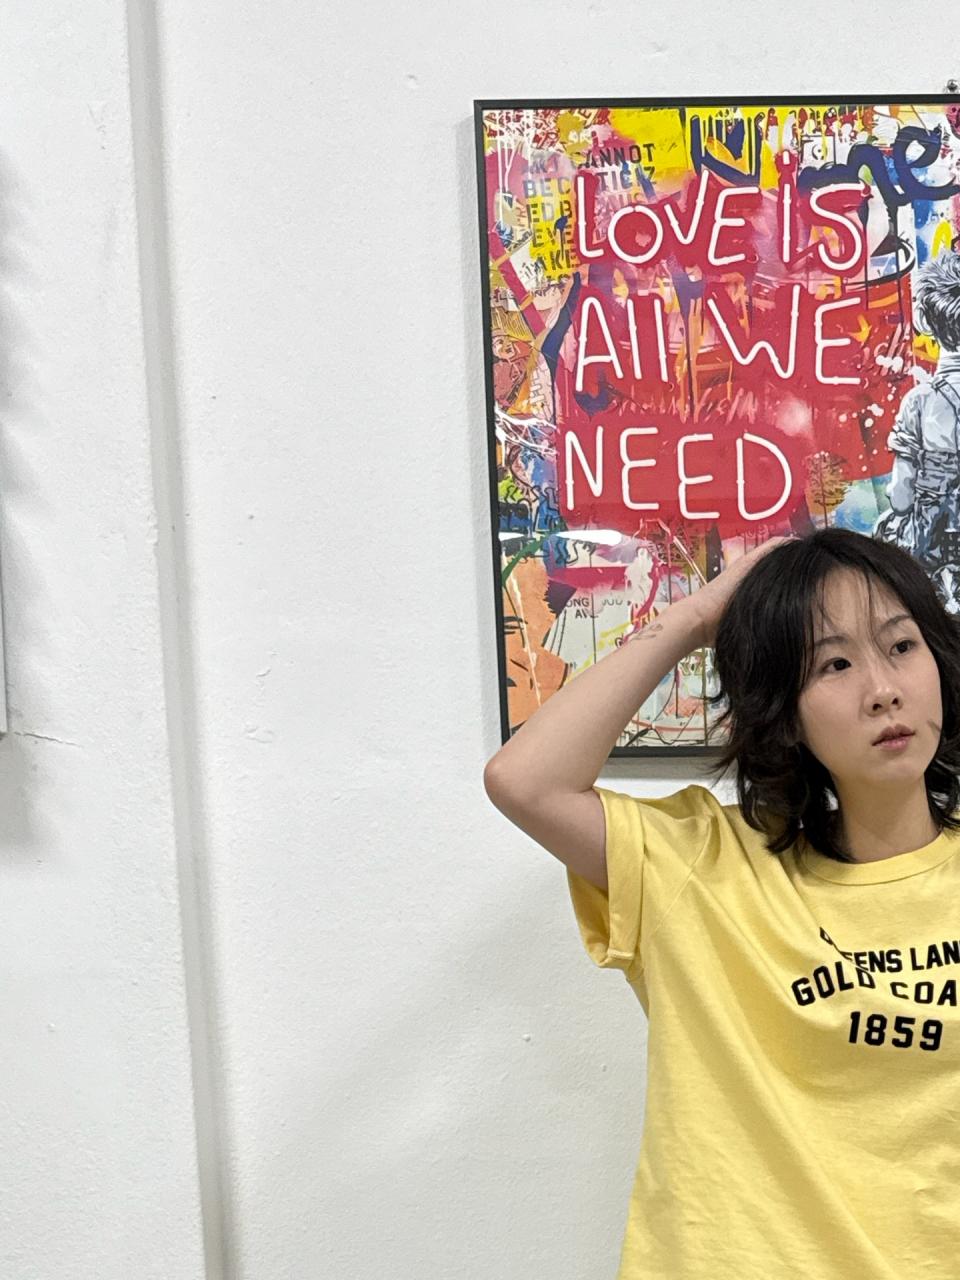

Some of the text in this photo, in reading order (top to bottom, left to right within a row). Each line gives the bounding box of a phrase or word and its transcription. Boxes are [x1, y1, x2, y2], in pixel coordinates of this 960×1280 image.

[574, 169, 761, 266] LOVE
[707, 284, 862, 384] WE
[565, 426, 793, 521] NEED
[791, 961, 876, 1006] GOLD
[848, 1011, 943, 1051] 1859
